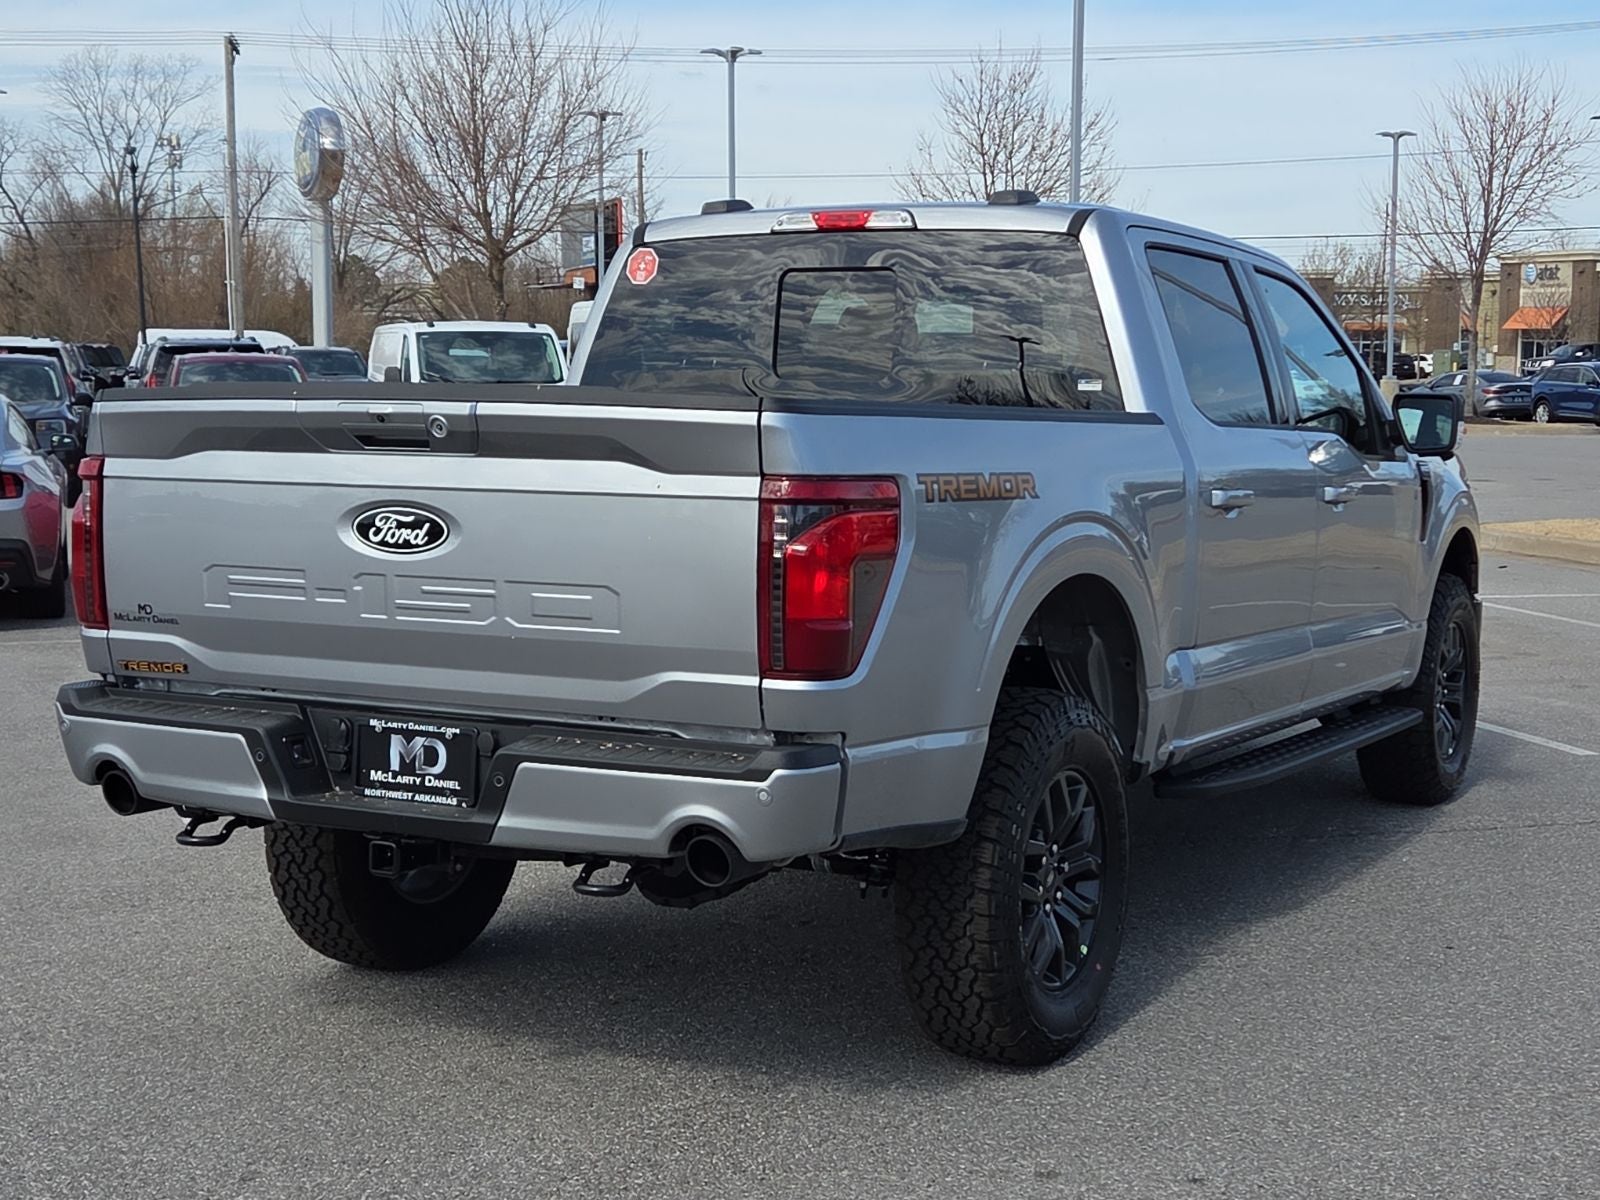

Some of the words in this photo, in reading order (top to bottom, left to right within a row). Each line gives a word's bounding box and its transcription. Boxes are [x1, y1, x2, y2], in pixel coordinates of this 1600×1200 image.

[916, 472, 1040, 503] TREMOR
[368, 512, 431, 545] Ford
[138, 604, 153, 615] MD
[203, 563, 621, 634] F-150
[118, 659, 189, 674] TREMOR
[390, 733, 447, 775] MD
[364, 788, 412, 801] NORTHWEST
[414, 793, 458, 806] ARKANSAS
